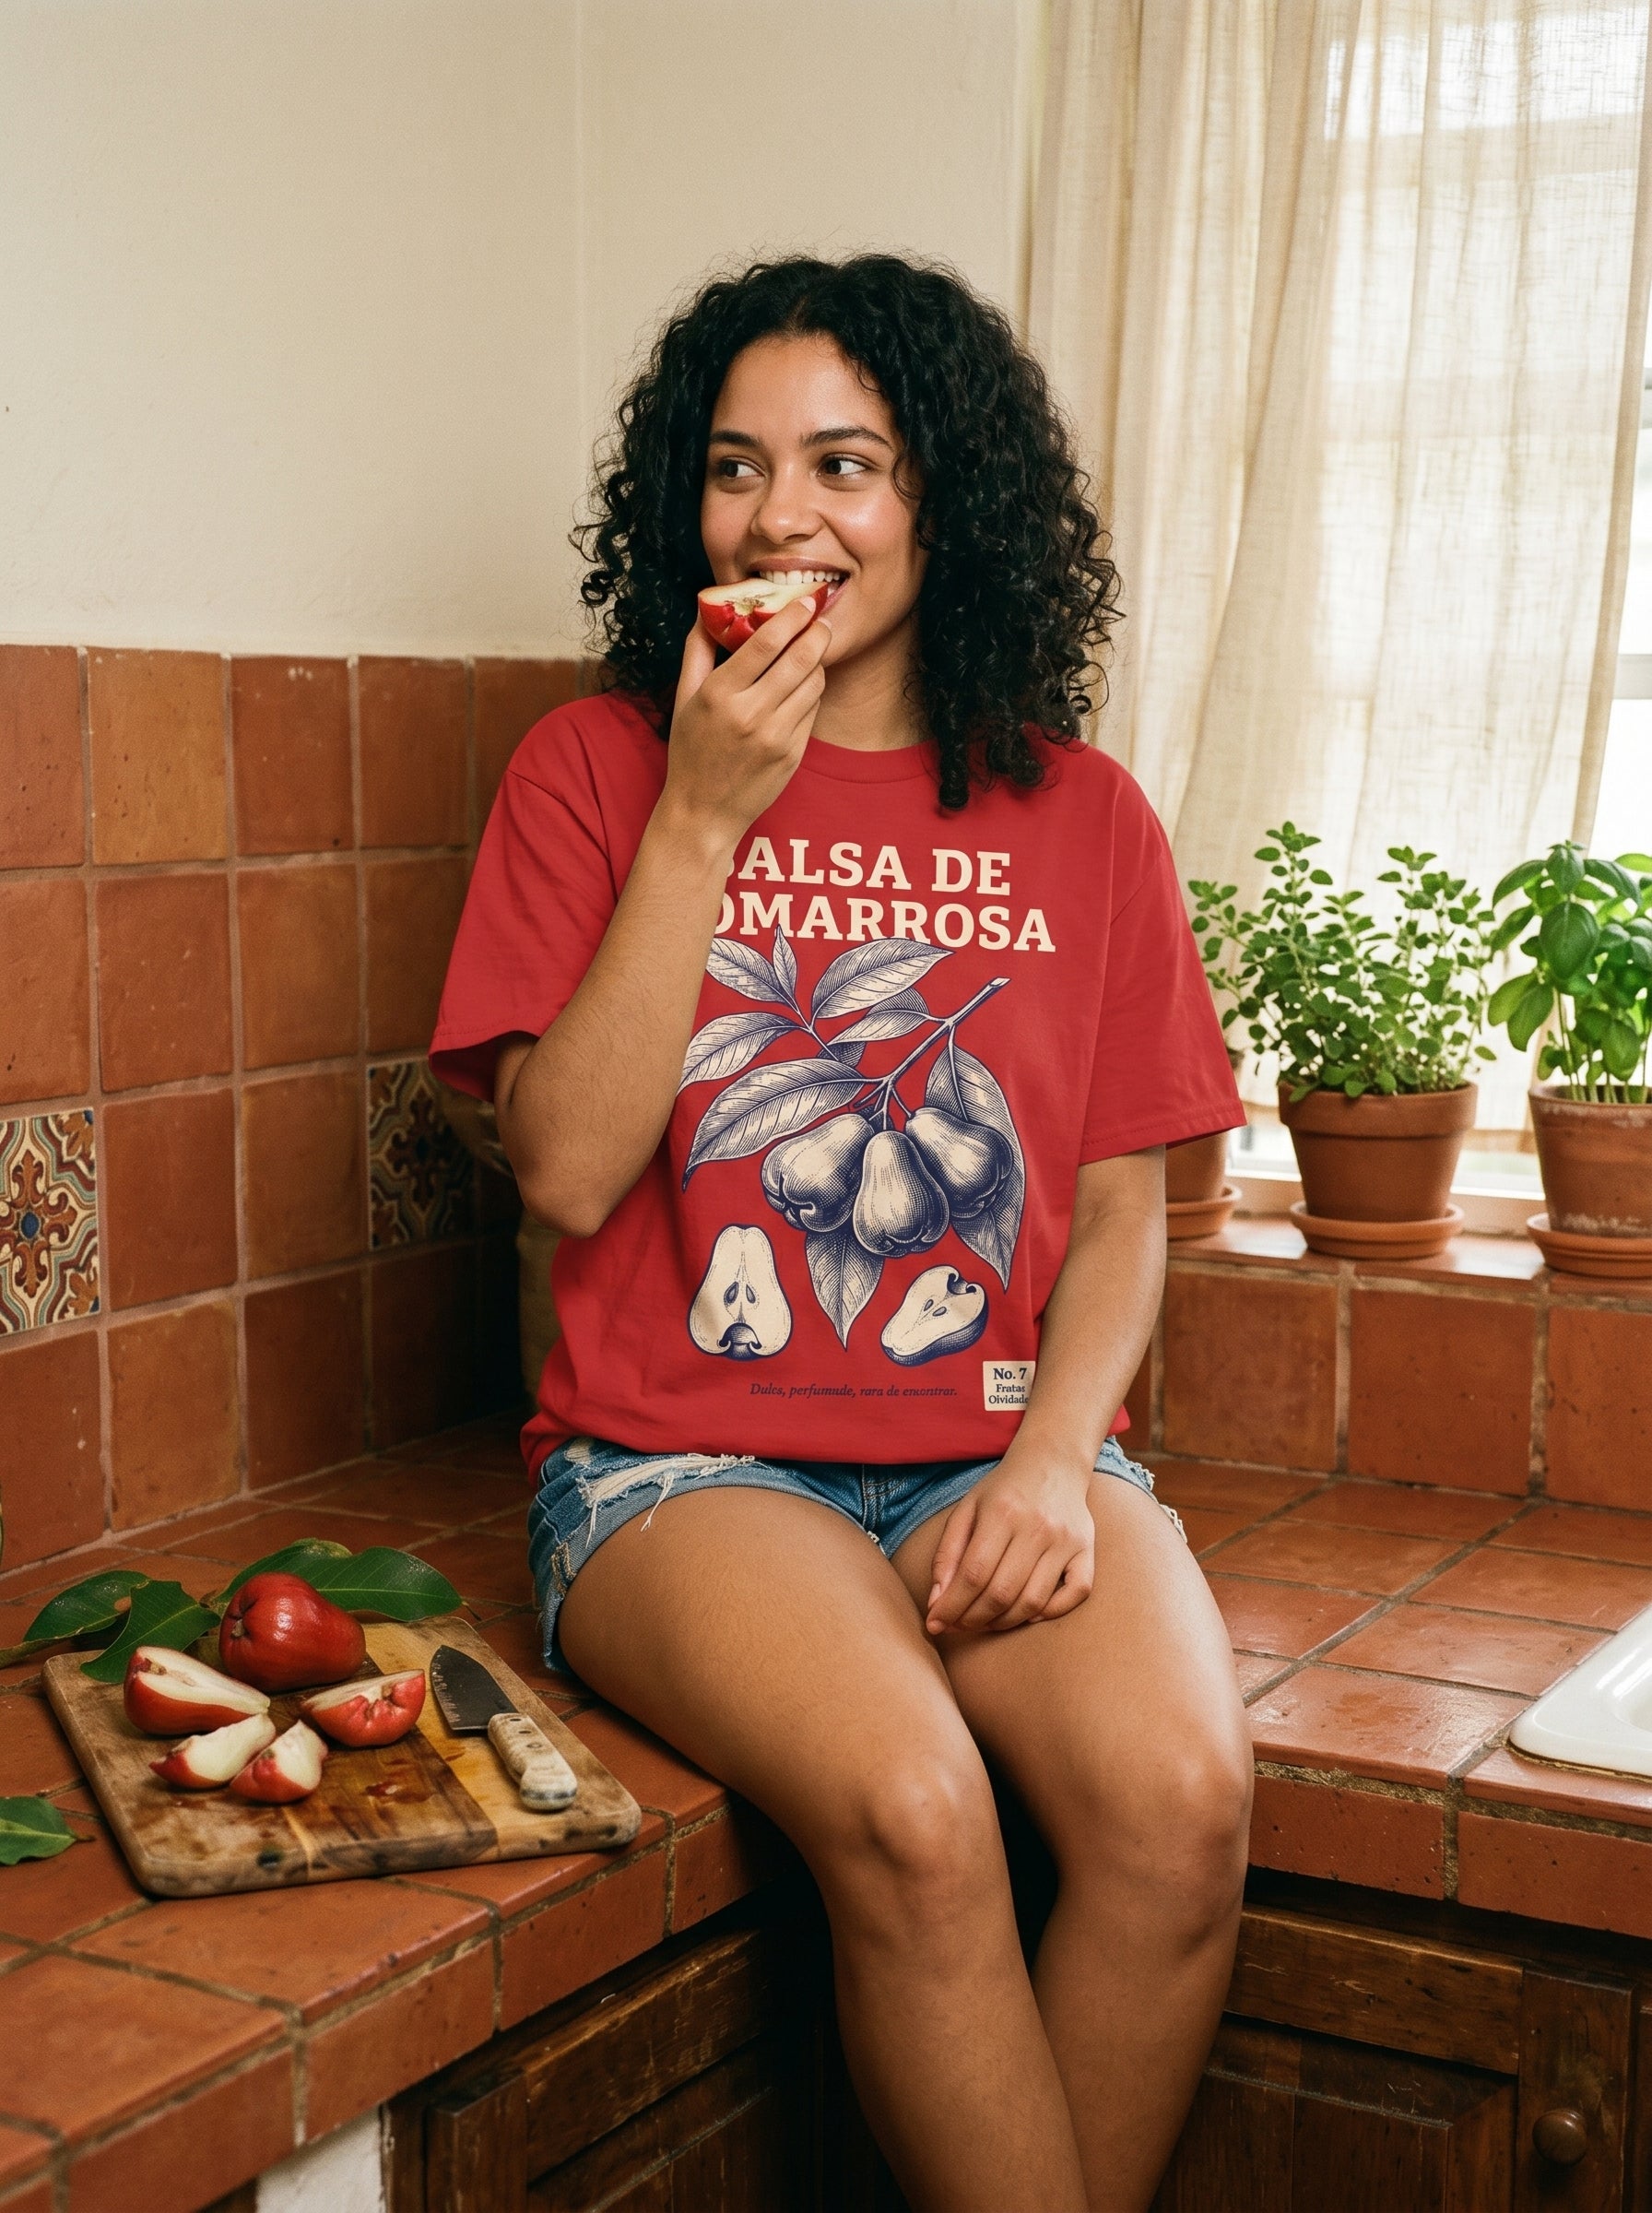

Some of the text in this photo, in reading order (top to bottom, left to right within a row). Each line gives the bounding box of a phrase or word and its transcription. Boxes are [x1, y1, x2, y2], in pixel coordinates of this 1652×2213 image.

[726, 836, 1010, 896] ALSA DE
[993, 1367, 1028, 1380] No. 7
[859, 1387, 883, 1396] rara
[887, 1384, 900, 1396] de
